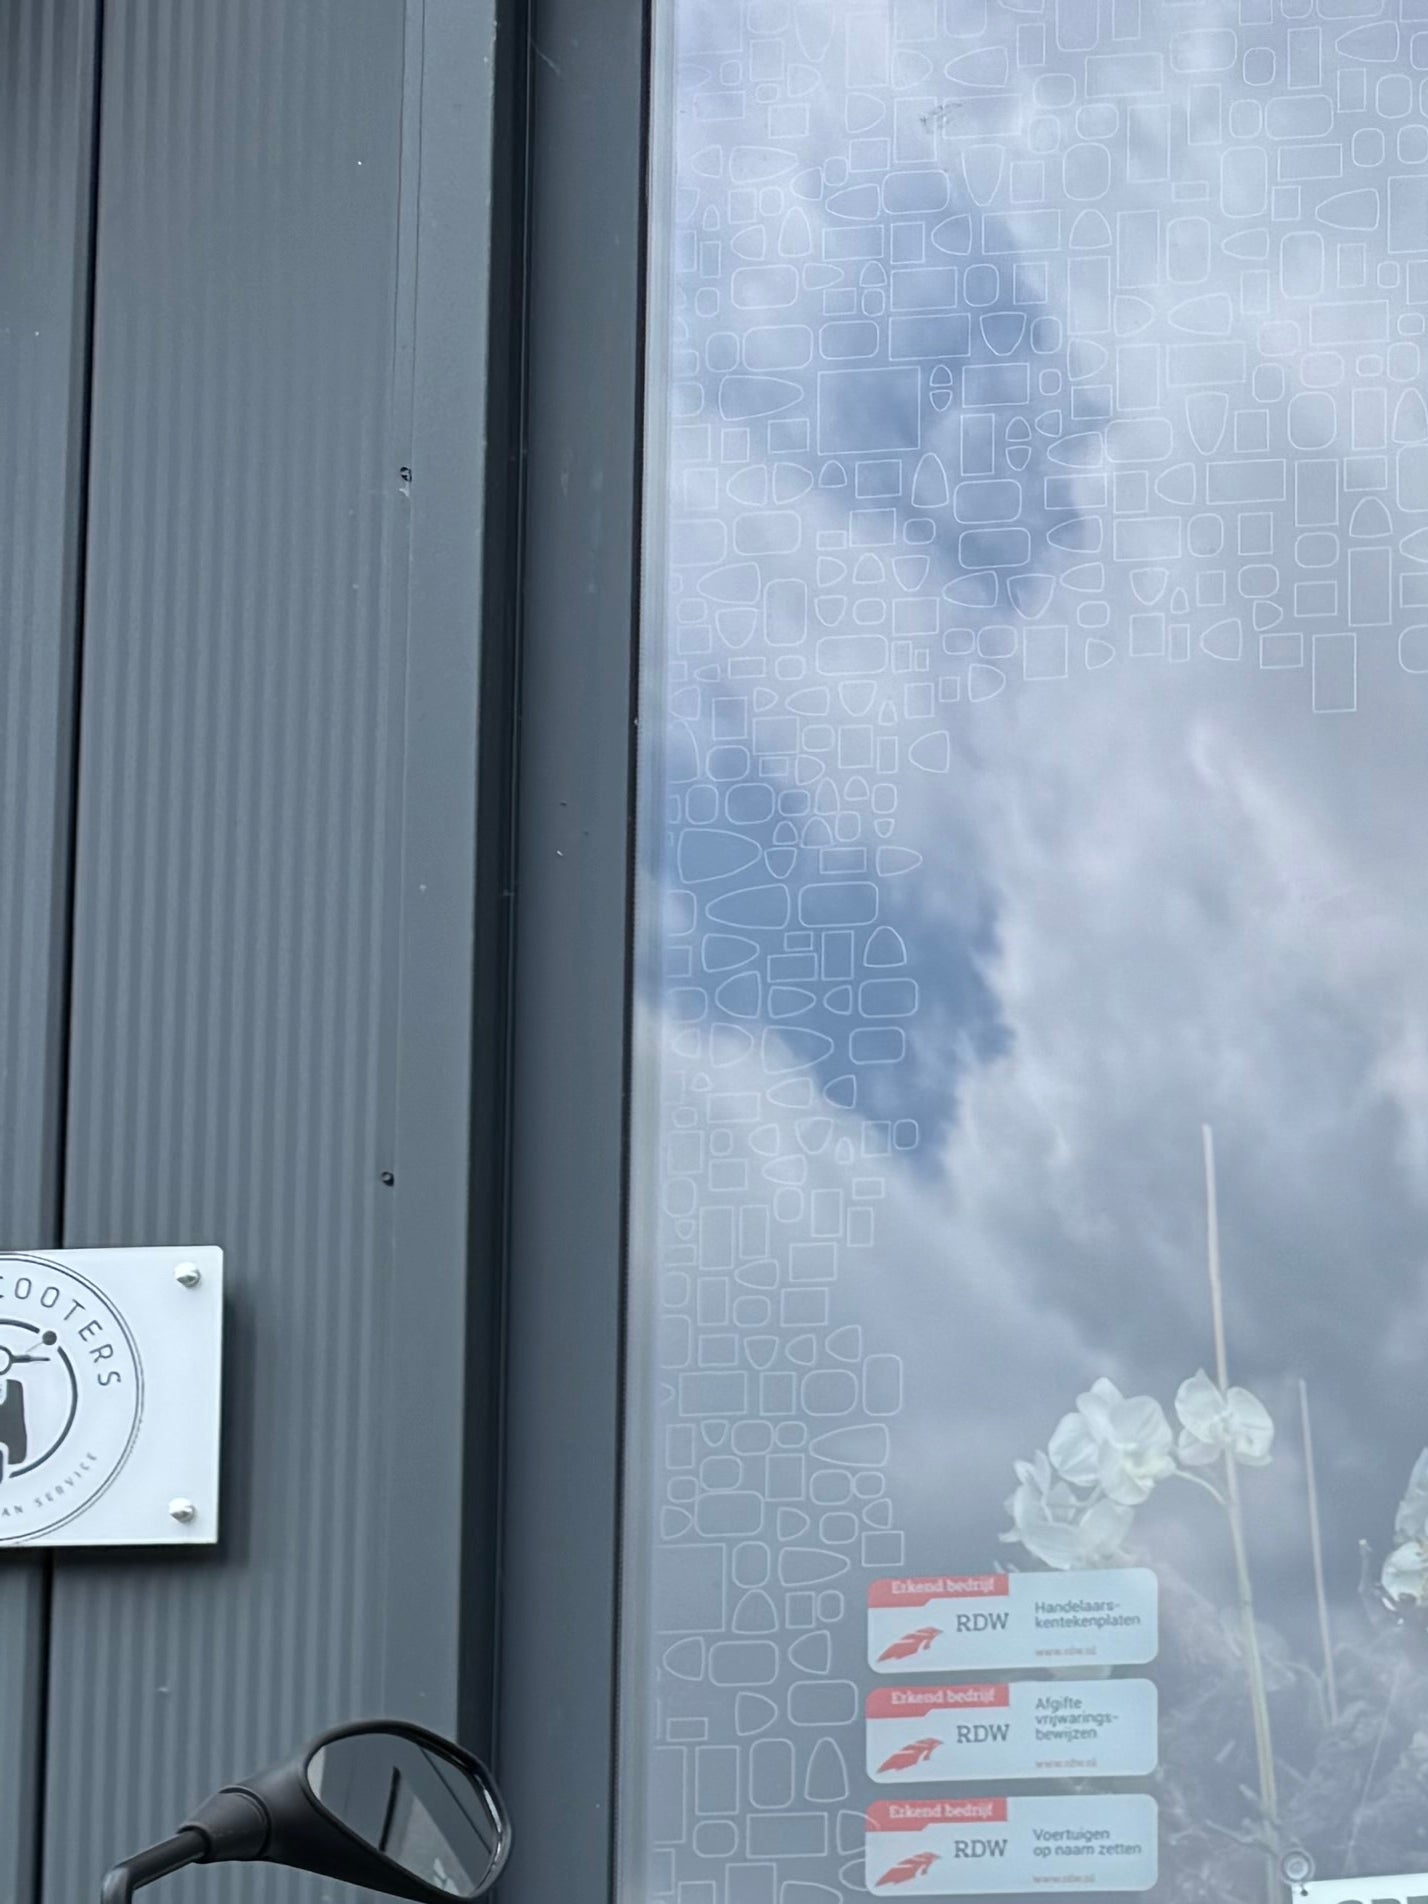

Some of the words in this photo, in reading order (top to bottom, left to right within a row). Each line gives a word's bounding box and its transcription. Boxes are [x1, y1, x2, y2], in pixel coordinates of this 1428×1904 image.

[0, 1276, 121, 1386] OOTERS
[34, 1452, 98, 1507] SERVICE
[892, 1579, 944, 1594] Erkend
[946, 1577, 994, 1594] bedrijf
[956, 1612, 1009, 1632] RDW
[1034, 1614, 1141, 1629] kentekenplaten
[891, 1691, 944, 1705] Erkend
[946, 1688, 995, 1705] bedrijf
[1035, 1696, 1082, 1713] Afgifte
[956, 1724, 1010, 1743] RDW
[1035, 1727, 1098, 1742] bewijzen
[889, 1804, 941, 1818] Erkend
[944, 1803, 993, 1819] bedrijf
[1032, 1828, 1110, 1843] Voertuigen
[954, 1839, 1008, 1858] RDW
[1033, 1846, 1052, 1858] op
[1054, 1845, 1095, 1856] naam
[1098, 1843, 1142, 1855] zetten
